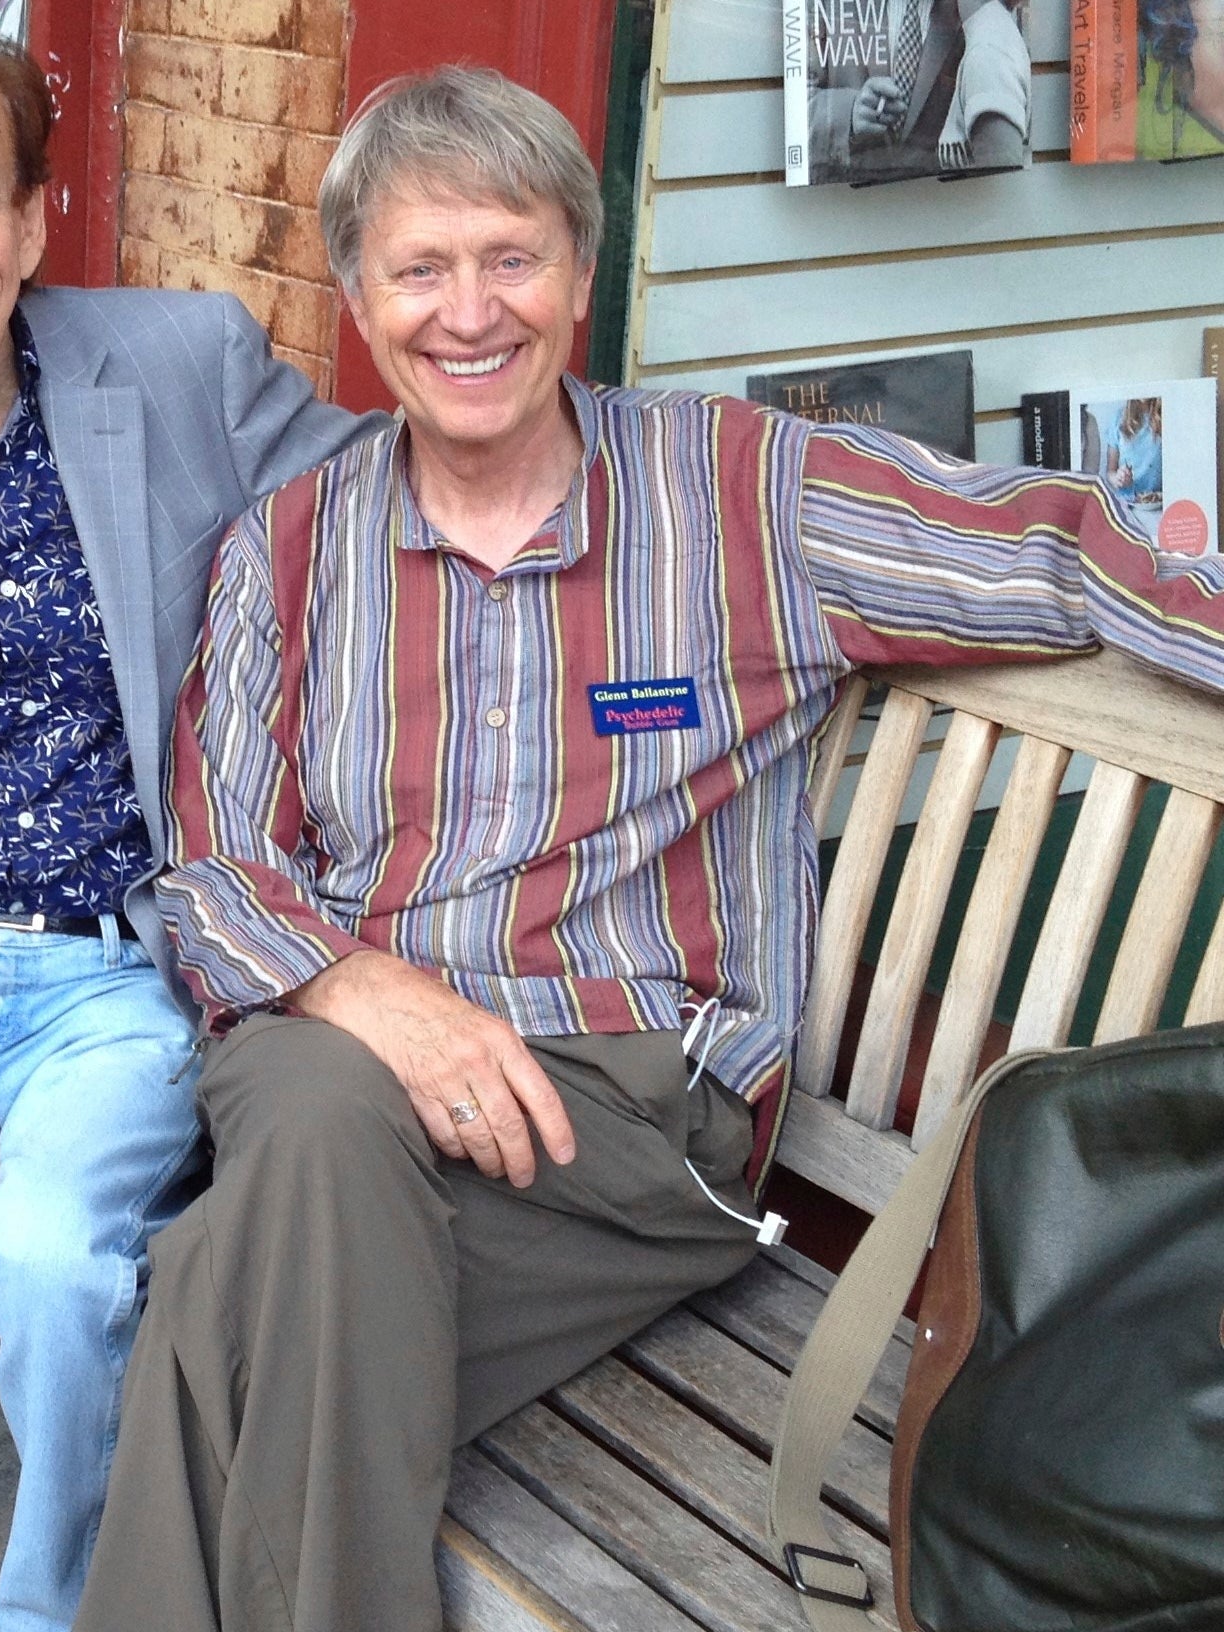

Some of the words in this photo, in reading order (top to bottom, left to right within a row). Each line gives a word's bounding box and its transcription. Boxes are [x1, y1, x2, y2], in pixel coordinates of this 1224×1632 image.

[814, 0, 885, 35] NEW
[785, 6, 802, 79] WAVE
[815, 34, 887, 68] WAVE
[1074, 38, 1091, 127] Travels
[783, 381, 829, 408] THE
[1035, 416, 1044, 462] modern
[594, 690, 629, 702] Glenn
[631, 686, 689, 699] Ballantyne
[605, 705, 685, 722] Psychedelic
